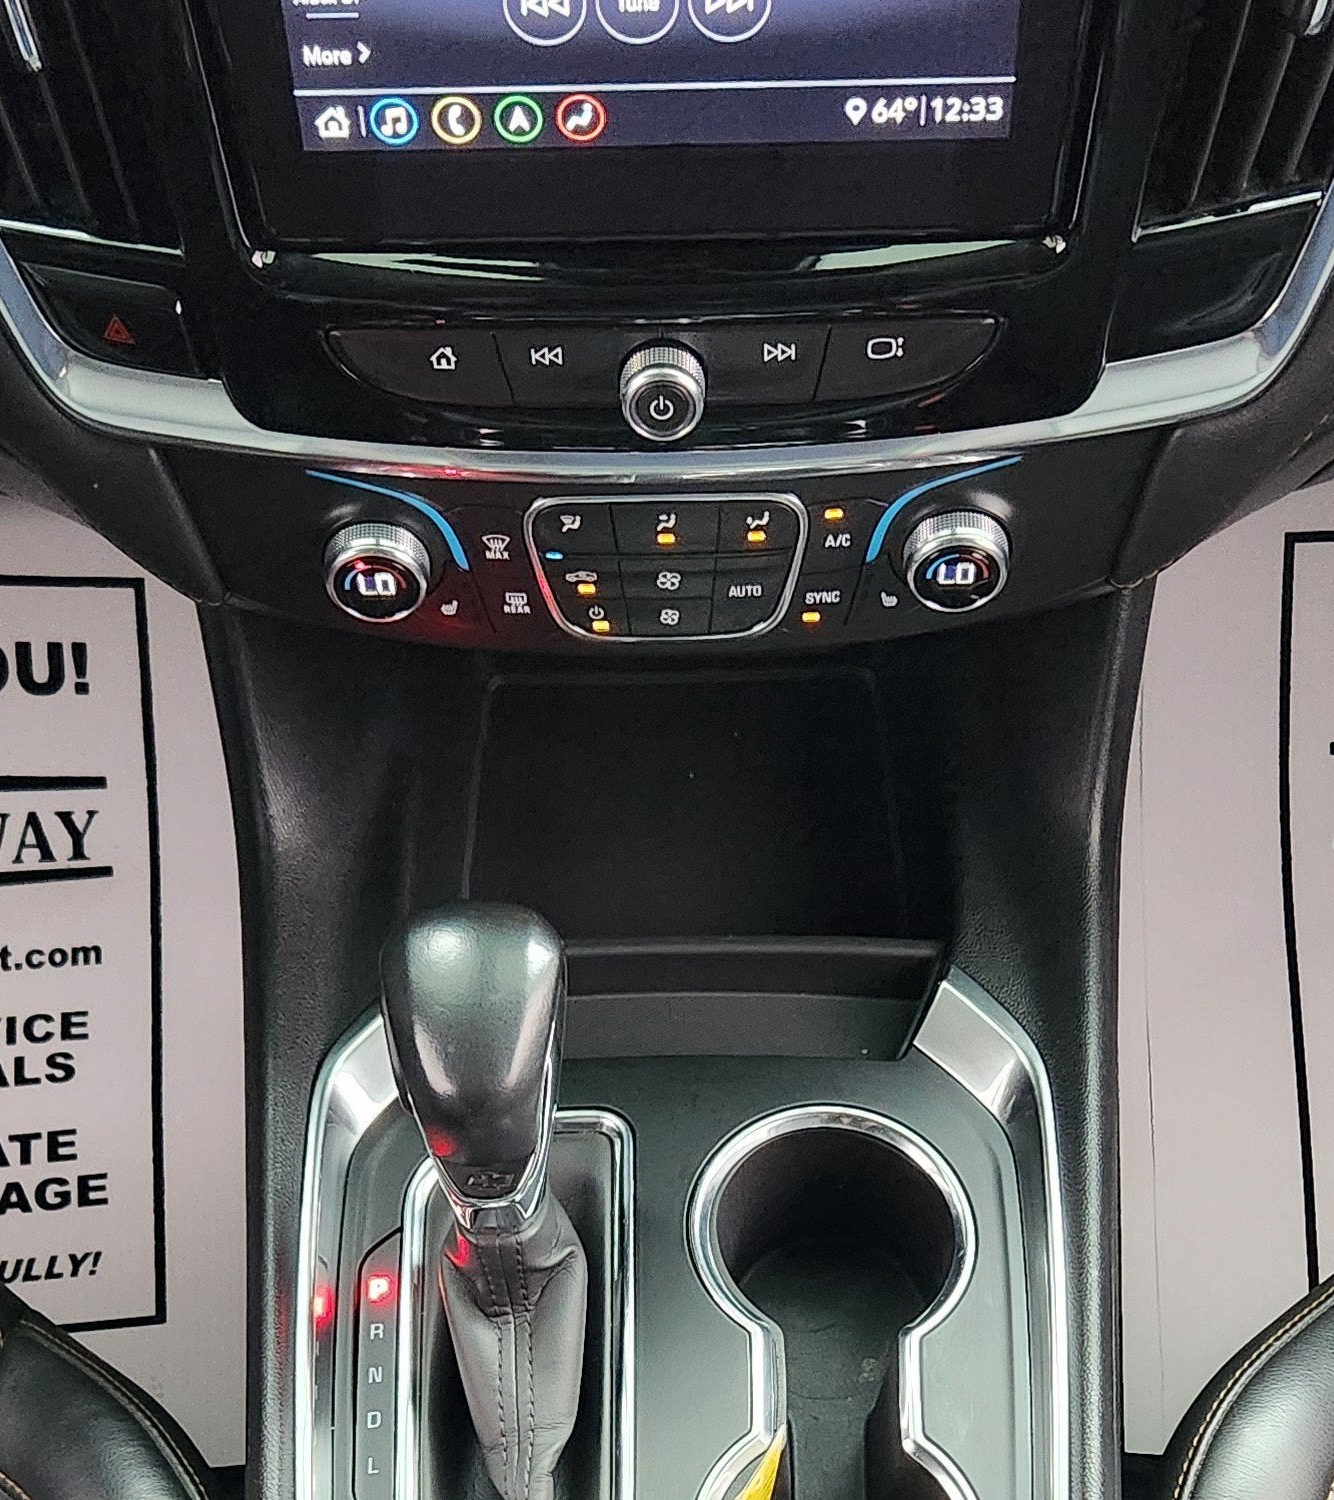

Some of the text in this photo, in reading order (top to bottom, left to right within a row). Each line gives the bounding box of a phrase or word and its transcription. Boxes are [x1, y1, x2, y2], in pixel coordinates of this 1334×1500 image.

[302, 45, 353, 66] More
[930, 96, 1004, 124] 12:33
[825, 534, 851, 548] A/C
[486, 551, 510, 560] MAX
[728, 585, 762, 598] AUTO
[805, 591, 841, 605] SYNC
[504, 604, 531, 614] REAR
[369, 1277, 390, 1300] P
[370, 1323, 385, 1341] R
[368, 1366, 383, 1384] N
[367, 1411, 382, 1429] D
[368, 1457, 380, 1475] L
